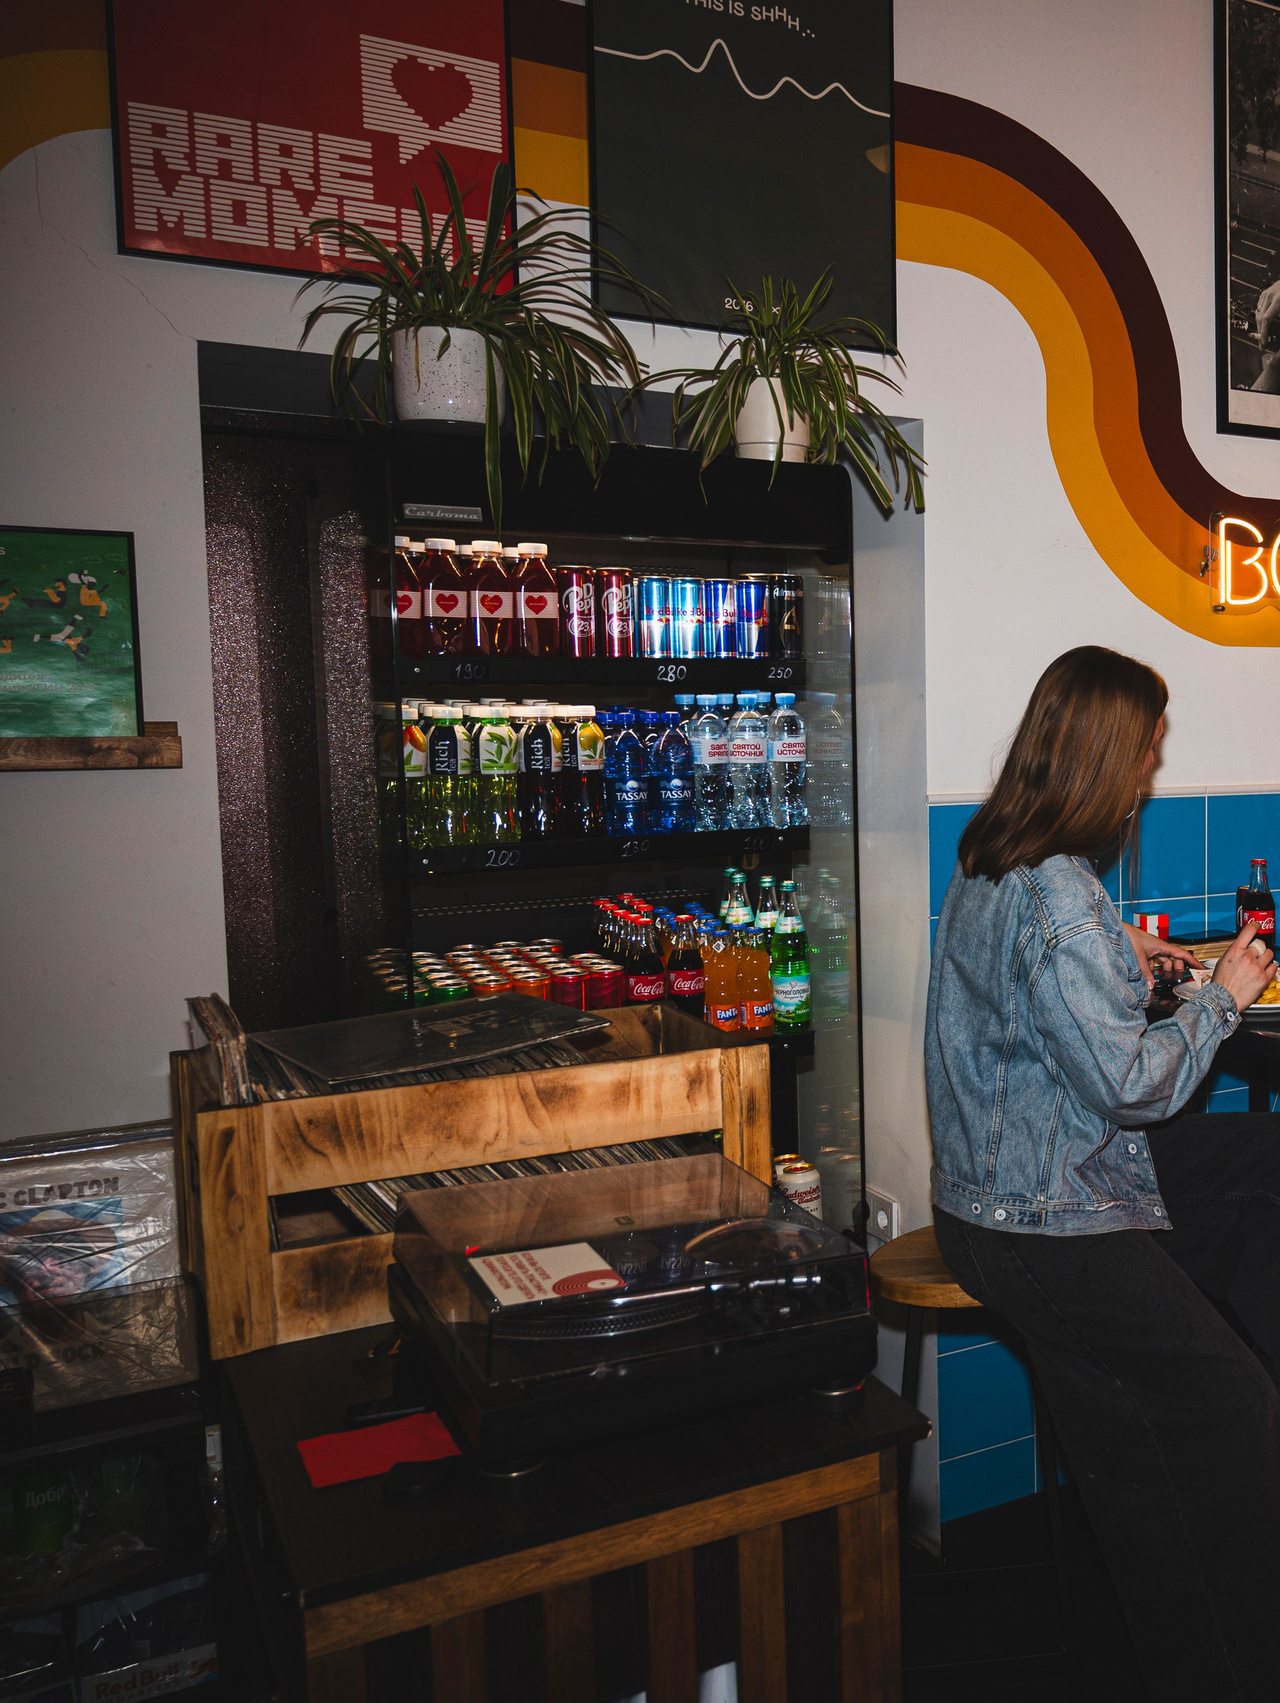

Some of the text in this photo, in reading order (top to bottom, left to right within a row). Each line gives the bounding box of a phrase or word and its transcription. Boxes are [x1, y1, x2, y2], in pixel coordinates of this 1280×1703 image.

[729, 0, 745, 17] IS
[128, 102, 374, 200] RARE
[724, 297, 753, 312] 206
[405, 507, 480, 520] Carboma
[454, 664, 485, 680] 190
[657, 665, 687, 682] 280
[768, 667, 792, 679] 250
[531, 738, 543, 770] Rich
[732, 743, 760, 751] СВЯТОЙ
[435, 740, 449, 772] Rich
[616, 791, 648, 800] TASSAY
[660, 789, 692, 799] TASSAY
[485, 850, 520, 867] 200
[13, 1176, 119, 1206] CLAPTON
[24, 1484, 66, 1510] Добр
[96, 1673, 137, 1699] Red
